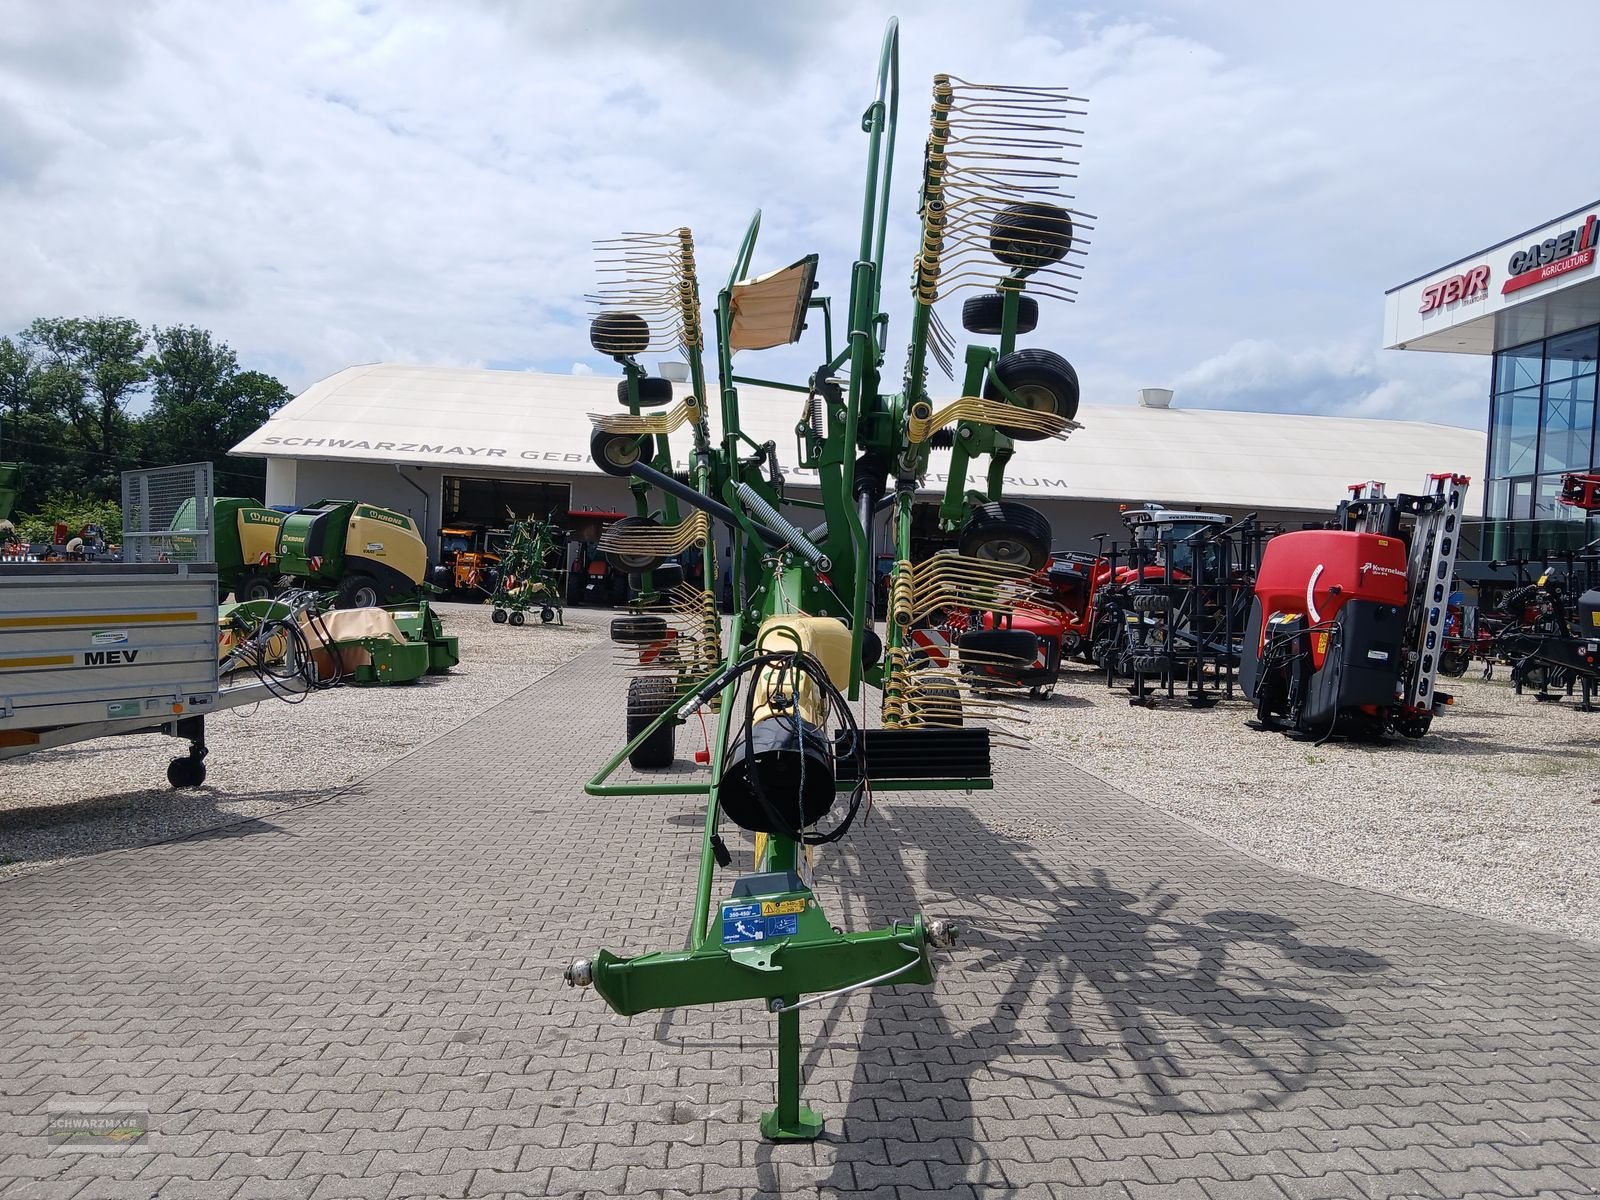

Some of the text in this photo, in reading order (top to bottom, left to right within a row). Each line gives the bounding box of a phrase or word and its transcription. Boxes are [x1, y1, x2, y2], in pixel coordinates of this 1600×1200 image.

[1541, 252, 1589, 277] AGRICULTURE
[1418, 264, 1491, 314] STEYR
[261, 436, 507, 458] SCHWARZMAYR
[377, 514, 403, 525] KRONE
[1372, 564, 1407, 577] Kverneland
[84, 650, 138, 665] MEV
